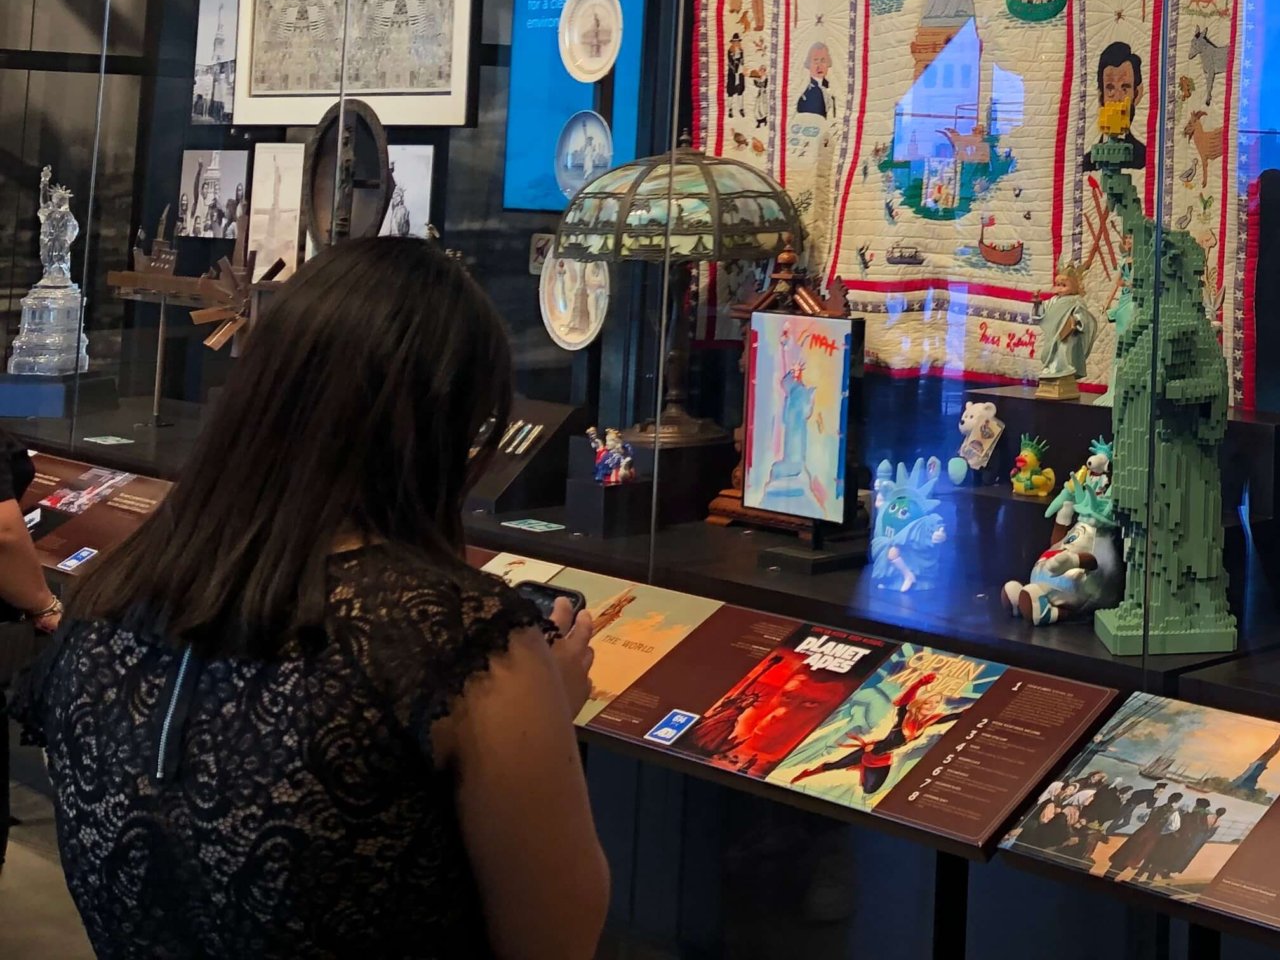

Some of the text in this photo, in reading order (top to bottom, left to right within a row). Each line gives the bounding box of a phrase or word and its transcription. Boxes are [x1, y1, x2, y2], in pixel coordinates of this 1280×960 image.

[906, 651, 986, 681] CAPTAIN
[886, 668, 973, 699] MRVEL
[1011, 681, 1022, 691] 1
[976, 718, 989, 728] 2
[965, 730, 977, 740] 3
[955, 742, 967, 752] 4
[942, 754, 954, 765] 5
[932, 766, 944, 776] 6
[919, 778, 932, 788] 7
[907, 791, 920, 802] 8
